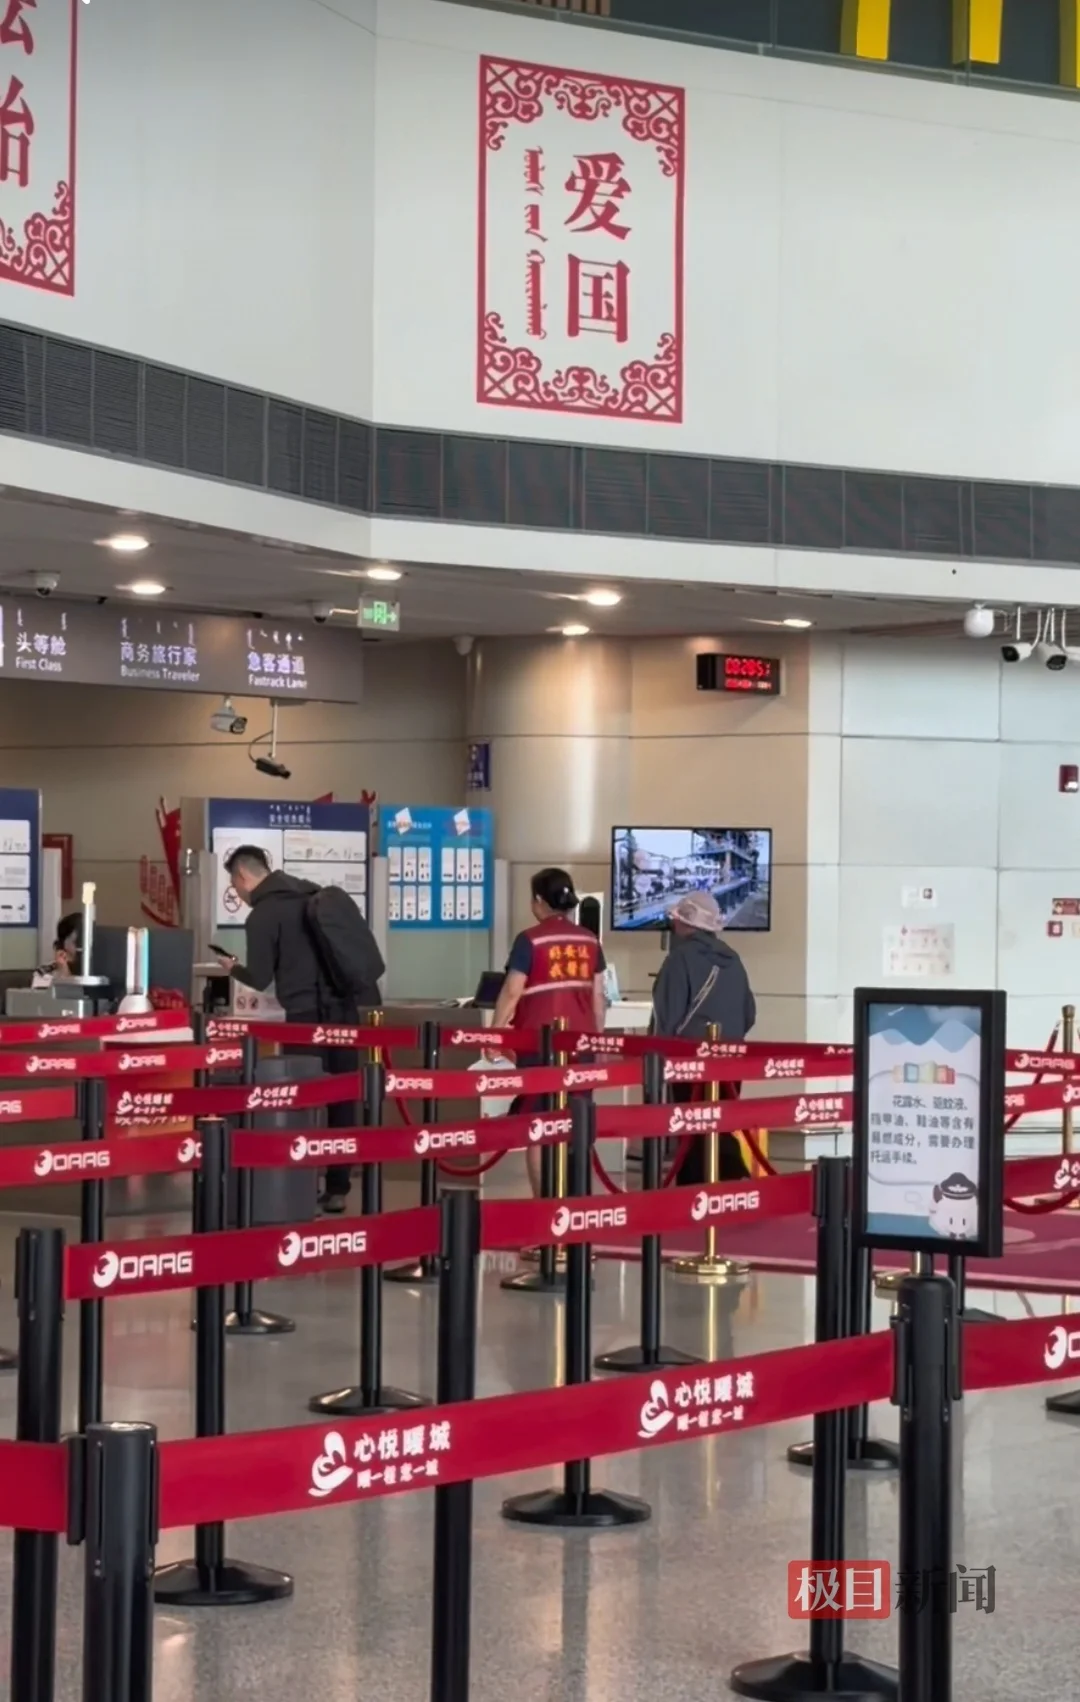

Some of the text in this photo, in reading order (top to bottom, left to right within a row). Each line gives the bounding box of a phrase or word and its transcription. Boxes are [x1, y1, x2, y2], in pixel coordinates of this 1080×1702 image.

[564, 153, 632, 343] 爱国
[16, 631, 67, 656] 头等舱
[120, 641, 198, 666] 商务旅行家
[15, 656, 62, 673] First Class
[120, 664, 200, 682] Business Traveler
[707, 1191, 760, 1215] OAAG
[568, 1206, 628, 1232] OAAG
[301, 1231, 368, 1259] OAAG
[119, 1250, 194, 1280] OAAG
